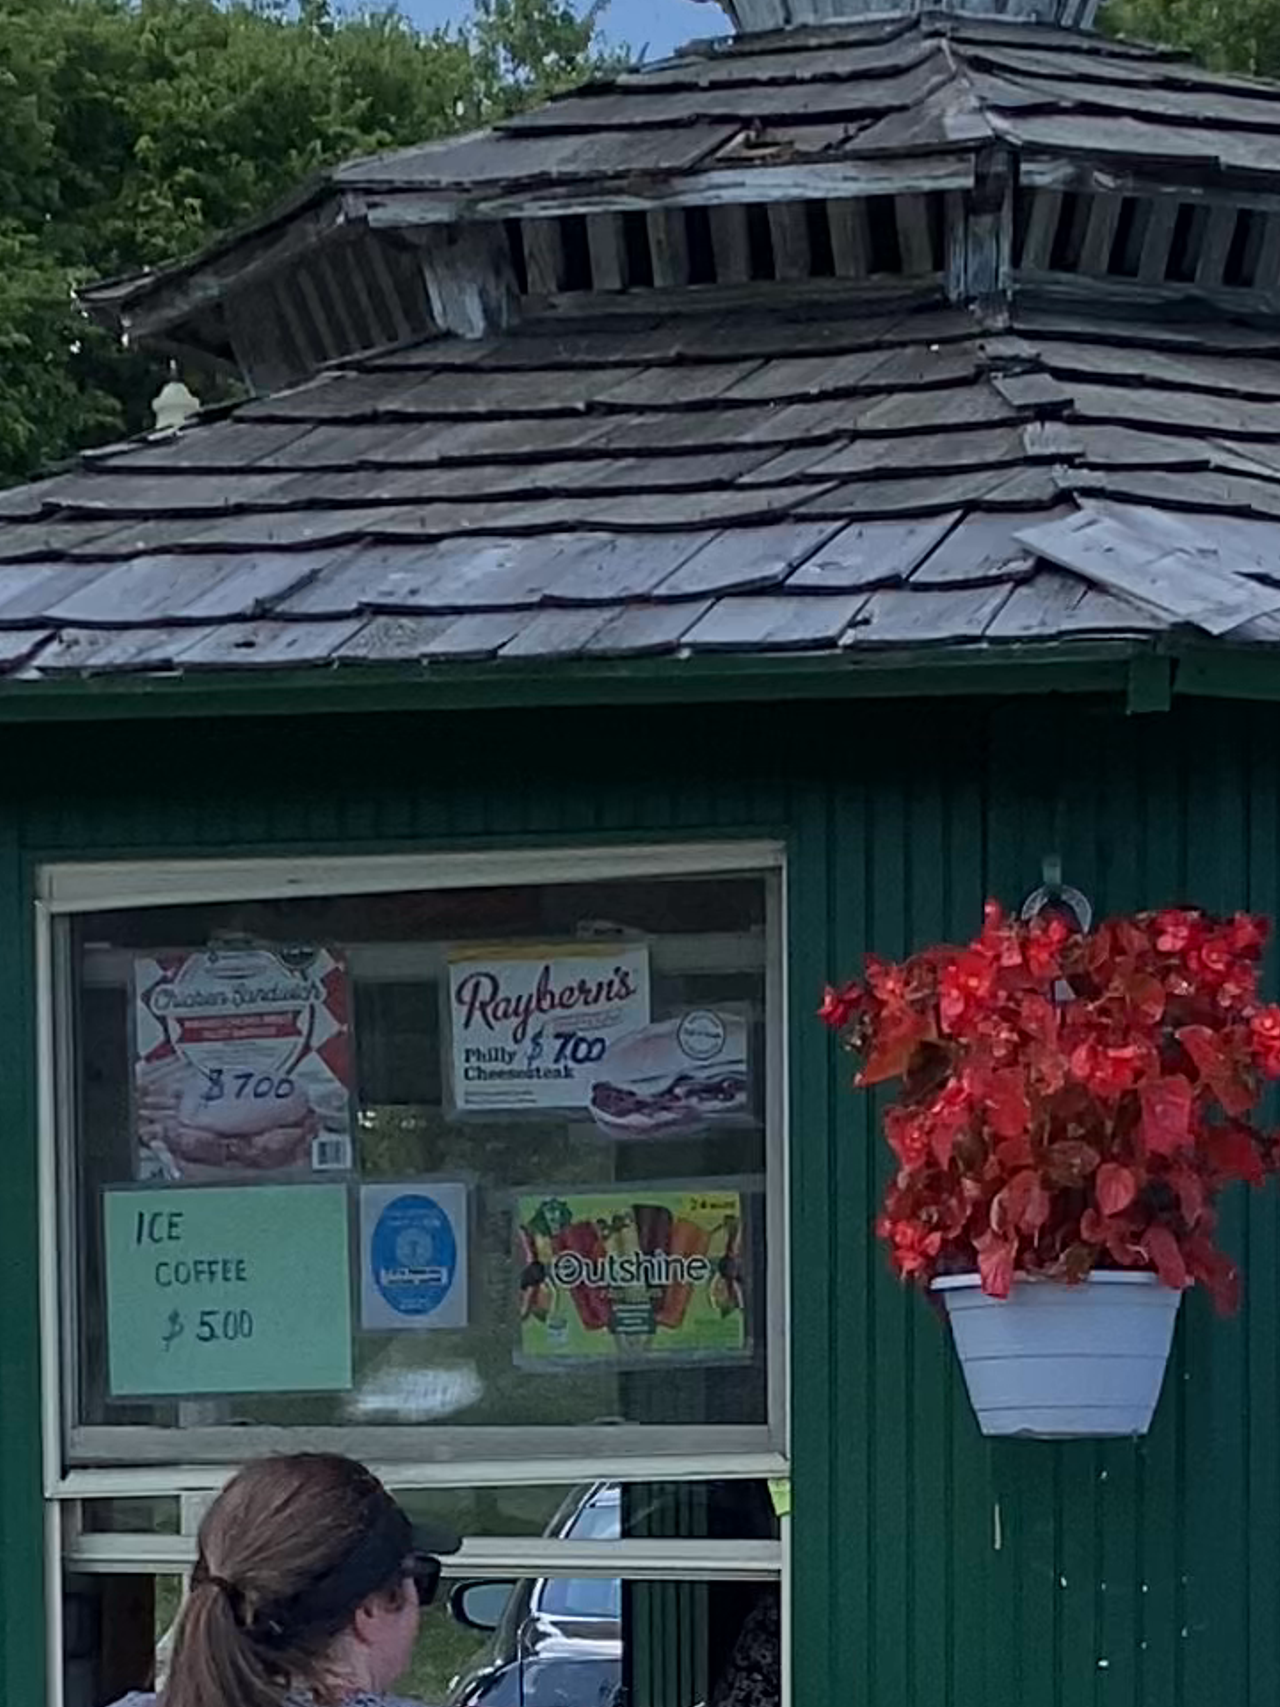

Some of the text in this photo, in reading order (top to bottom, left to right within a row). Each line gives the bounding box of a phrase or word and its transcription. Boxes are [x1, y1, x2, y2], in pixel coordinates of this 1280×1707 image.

[455, 964, 637, 1043] Raybern's
[464, 1046, 517, 1065] Philly
[136, 1211, 184, 1244] ICE
[155, 1259, 248, 1287] COFFEE
[552, 1249, 711, 1286] Outshine
